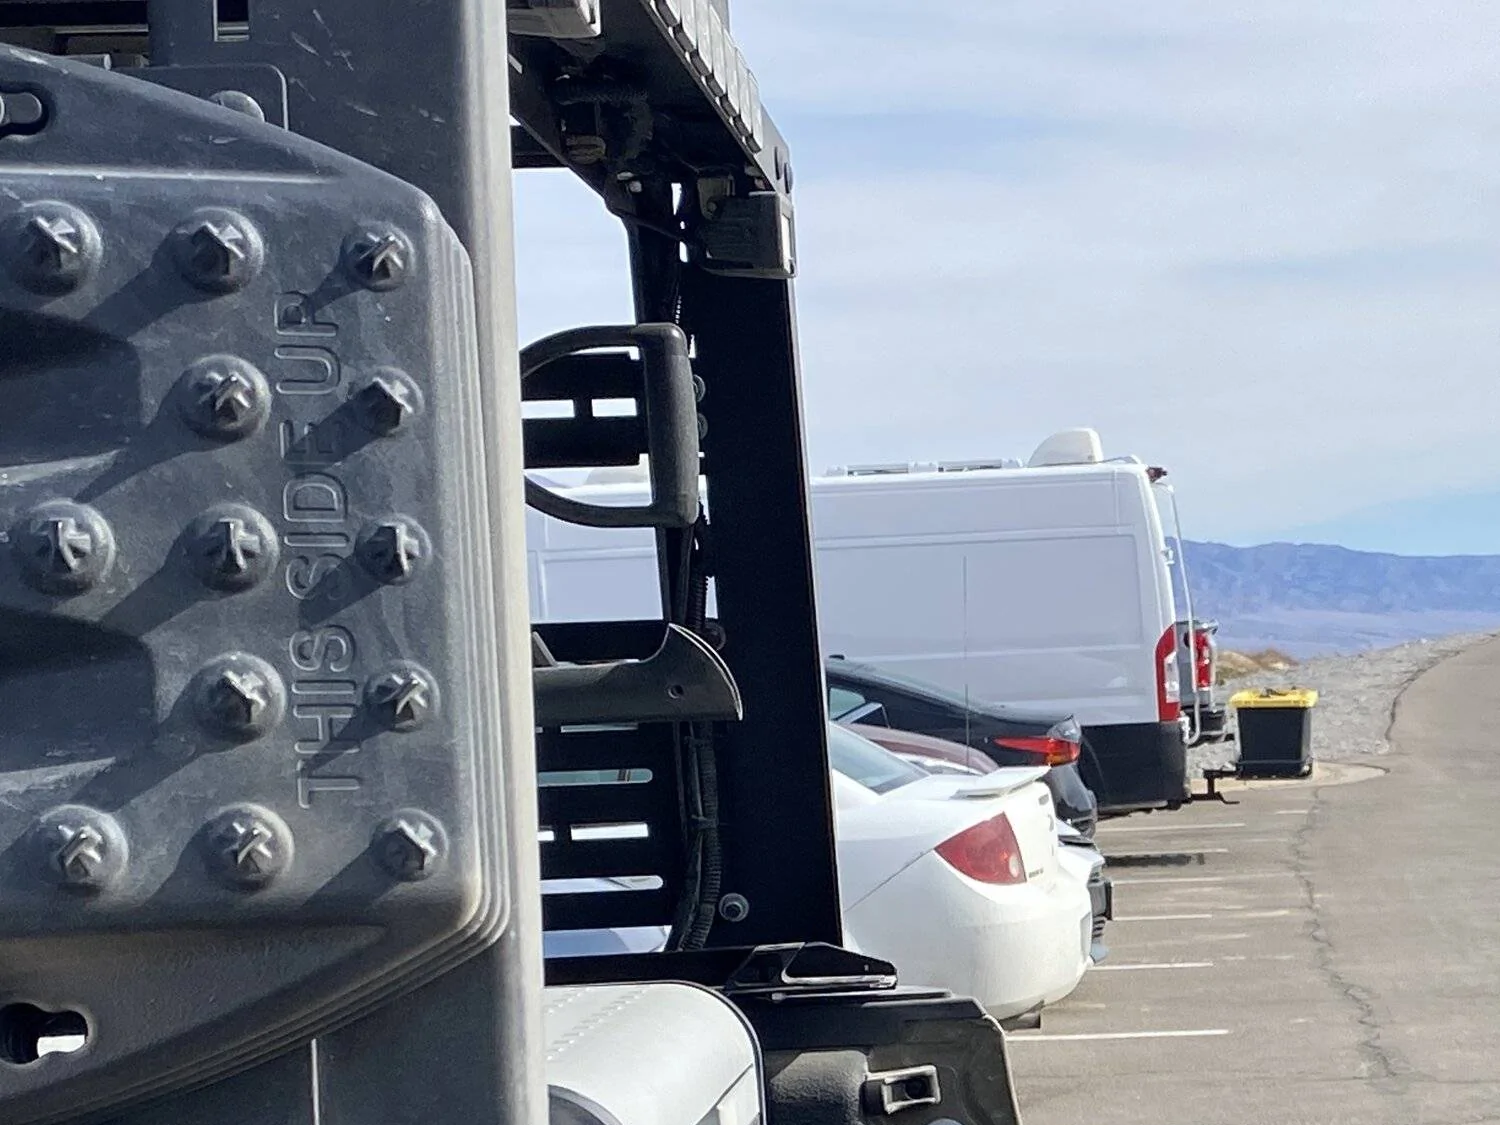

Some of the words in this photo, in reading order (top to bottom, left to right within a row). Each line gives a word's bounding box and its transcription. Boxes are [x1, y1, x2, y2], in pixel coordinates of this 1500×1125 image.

[275, 290, 342, 397] UP
[279, 420, 349, 600] SIDE
[289, 623, 363, 809] THIS
